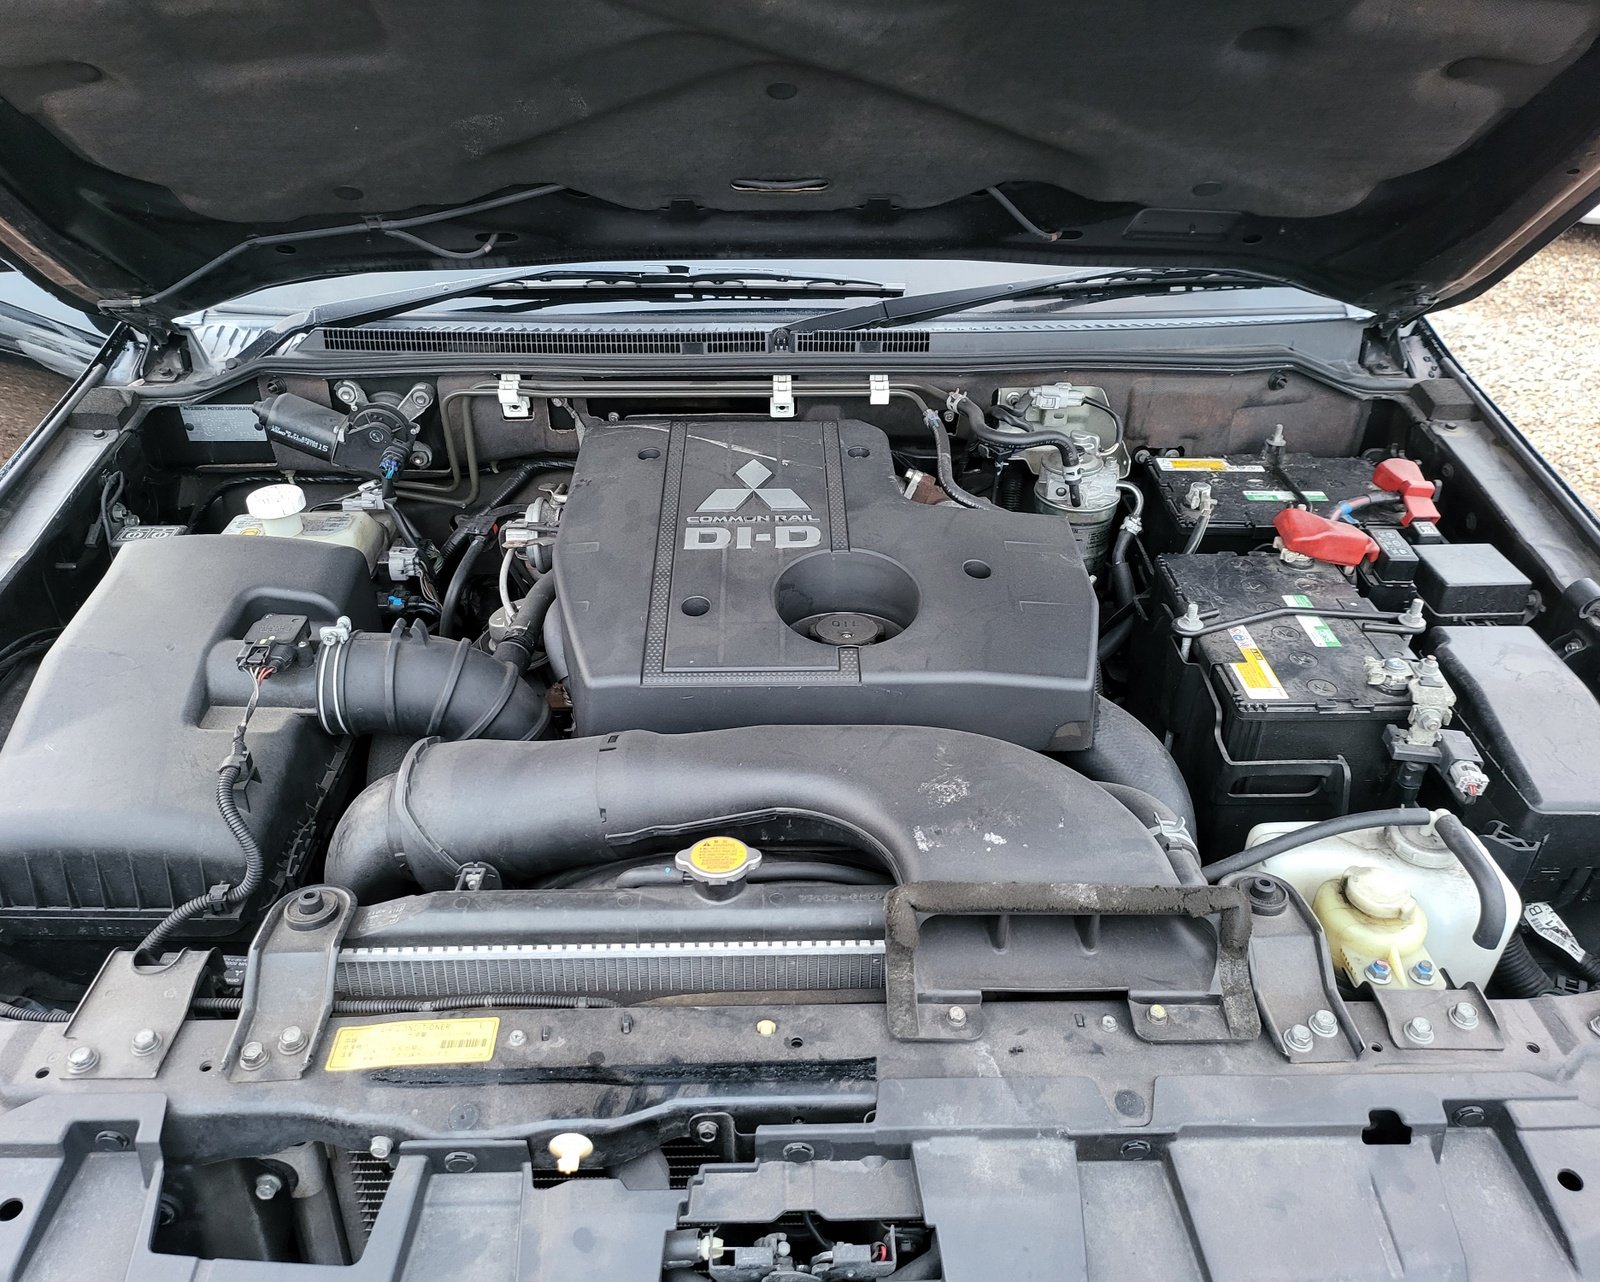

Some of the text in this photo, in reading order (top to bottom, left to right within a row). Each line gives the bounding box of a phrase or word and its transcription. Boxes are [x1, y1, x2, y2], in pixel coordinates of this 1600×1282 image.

[686, 514, 820, 524] COMMON RAIL
[683, 525, 822, 550] DI-D
[831, 620, 860, 628] OIL
